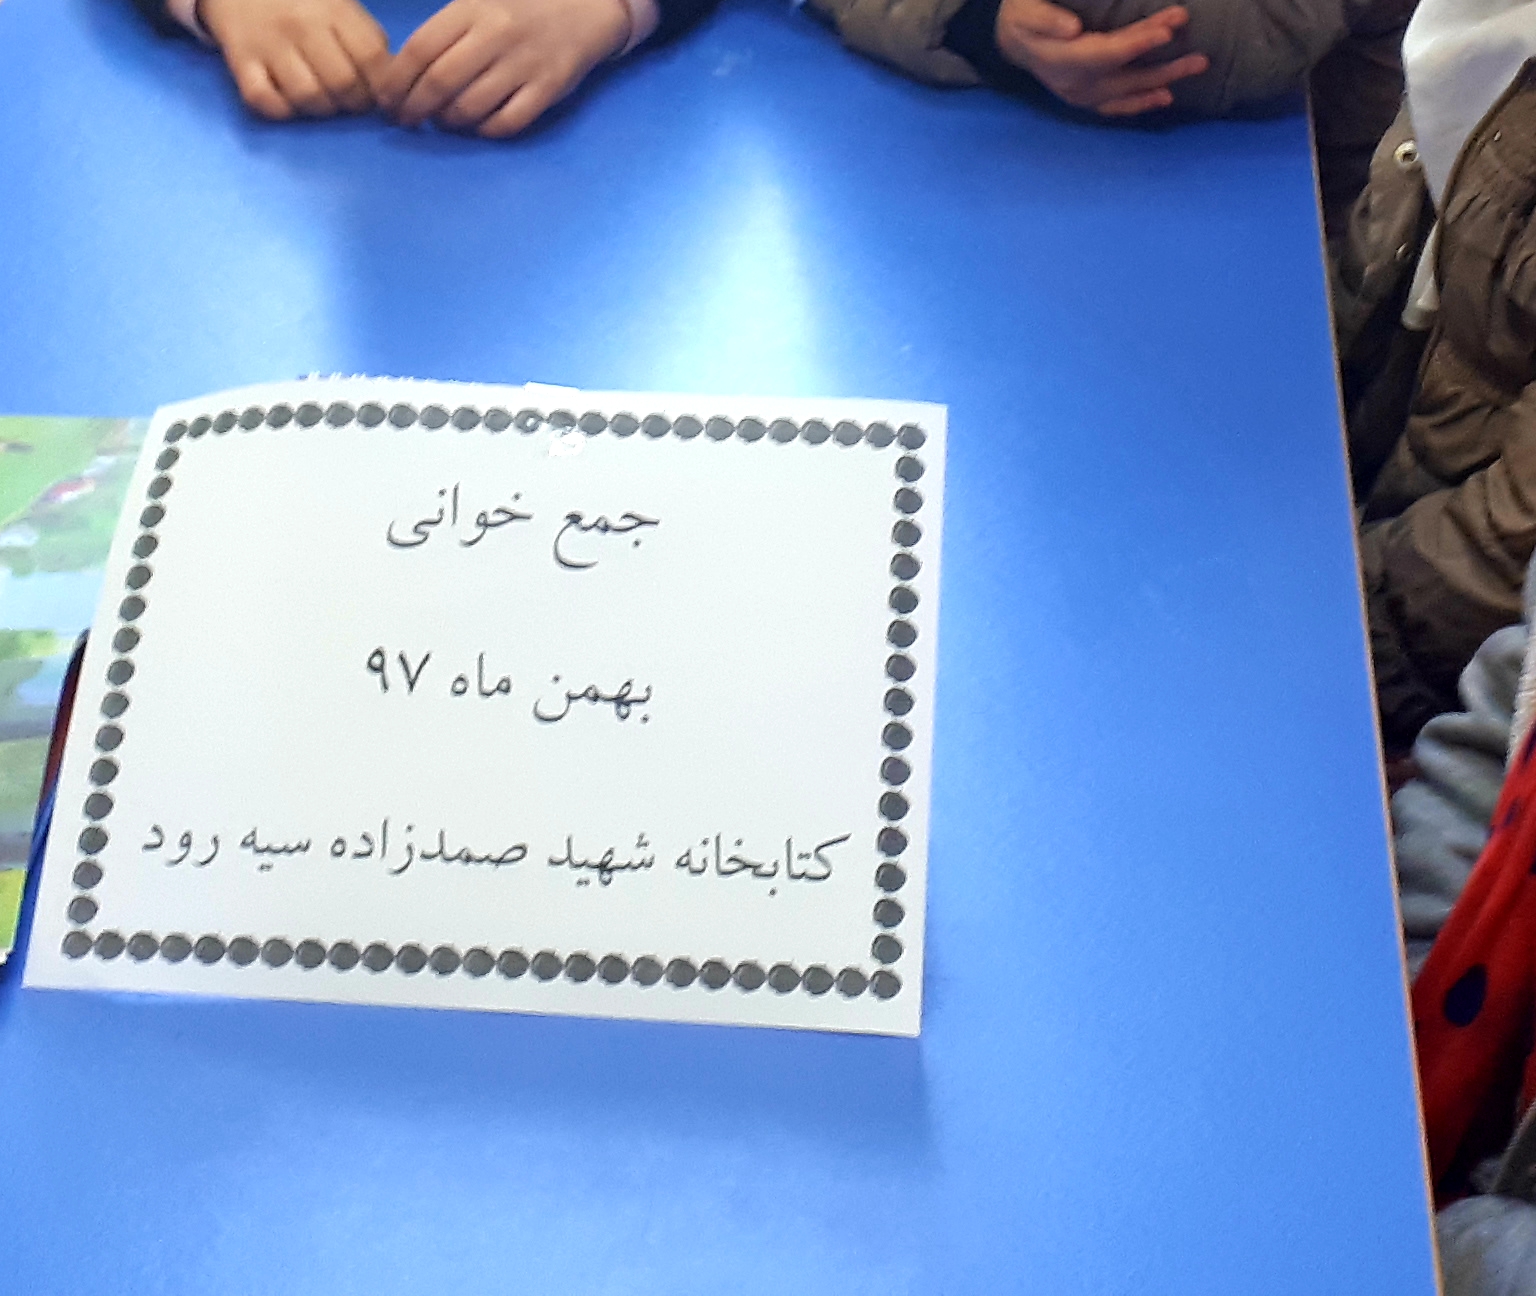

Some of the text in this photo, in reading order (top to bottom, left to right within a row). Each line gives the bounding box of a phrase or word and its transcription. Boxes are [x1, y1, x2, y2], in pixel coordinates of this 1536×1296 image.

[385, 481, 662, 572] جمع خوانی
[365, 644, 654, 725] بهمن ماه ۹۷
[140, 817, 853, 898] کتابخانه شهید صمدزاده سیه رود
